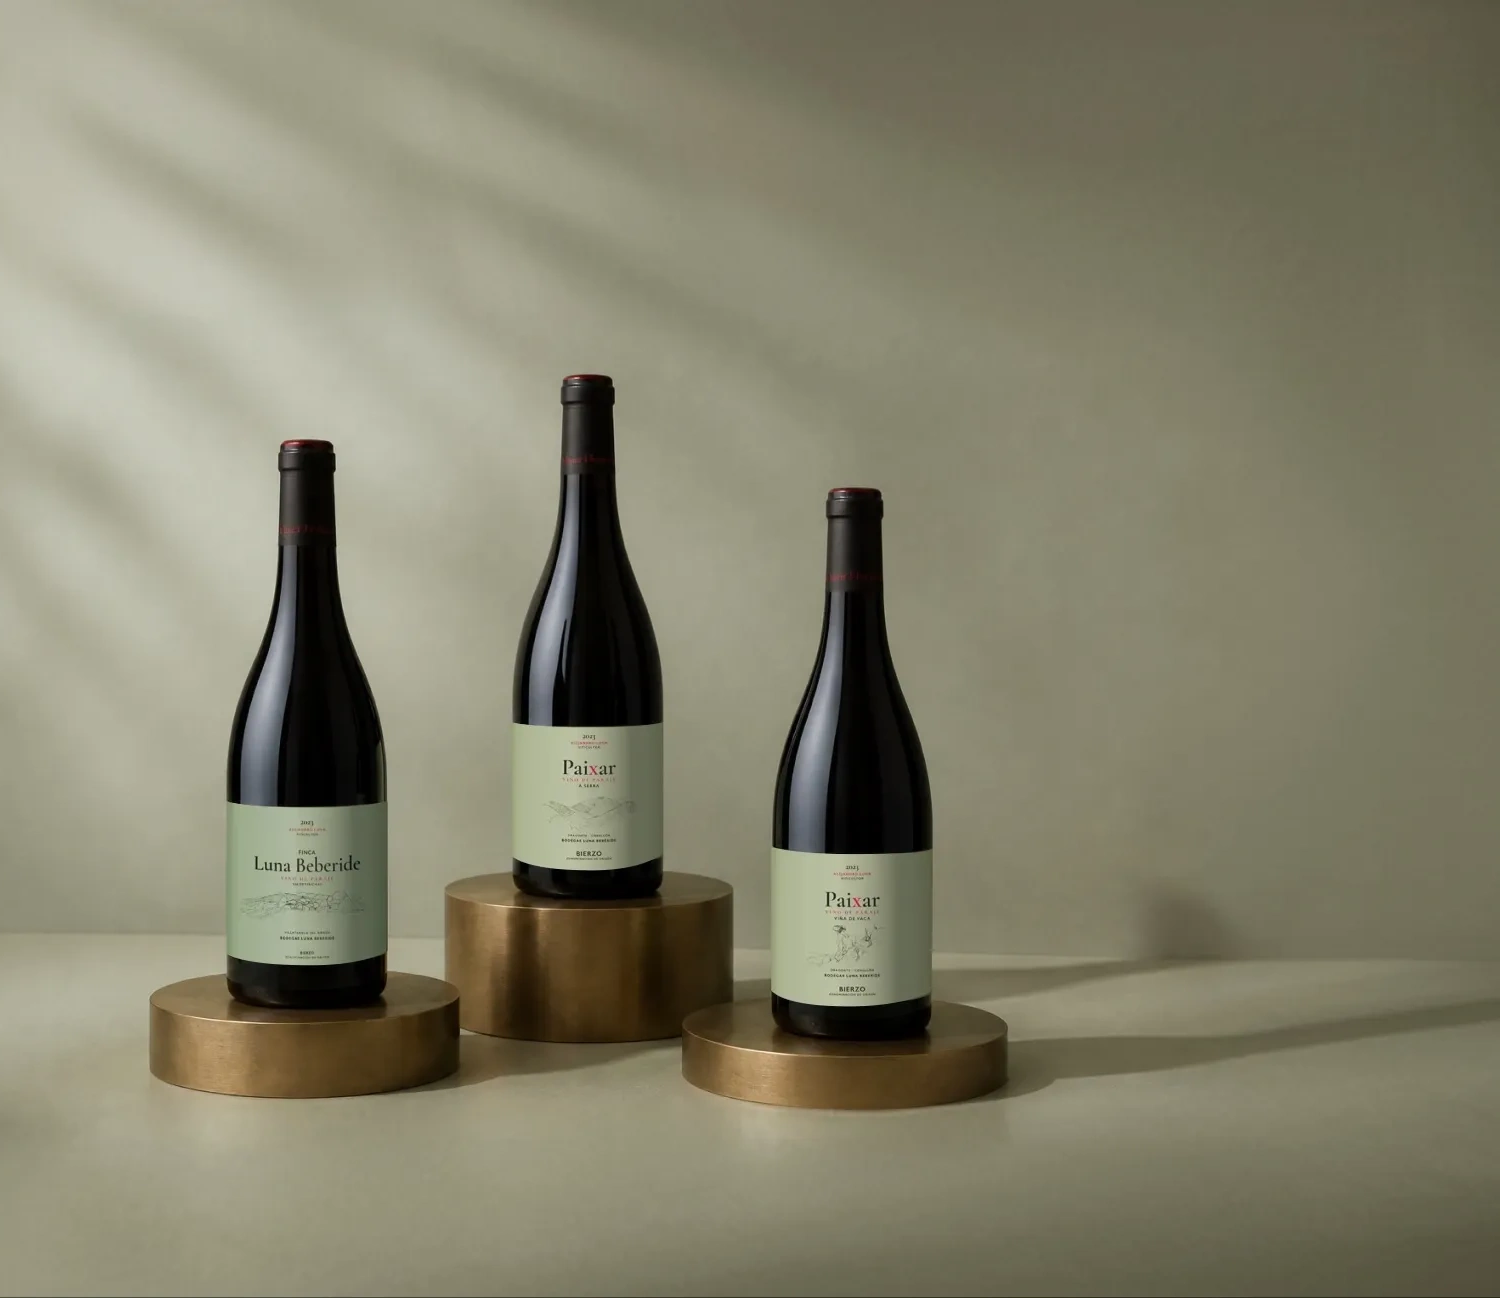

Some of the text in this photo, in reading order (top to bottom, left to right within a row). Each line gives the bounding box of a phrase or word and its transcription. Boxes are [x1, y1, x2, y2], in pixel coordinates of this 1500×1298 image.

[563, 759, 616, 775] Paixar
[254, 854, 361, 873] Luna Beberide
[825, 891, 881, 908] Paixar
